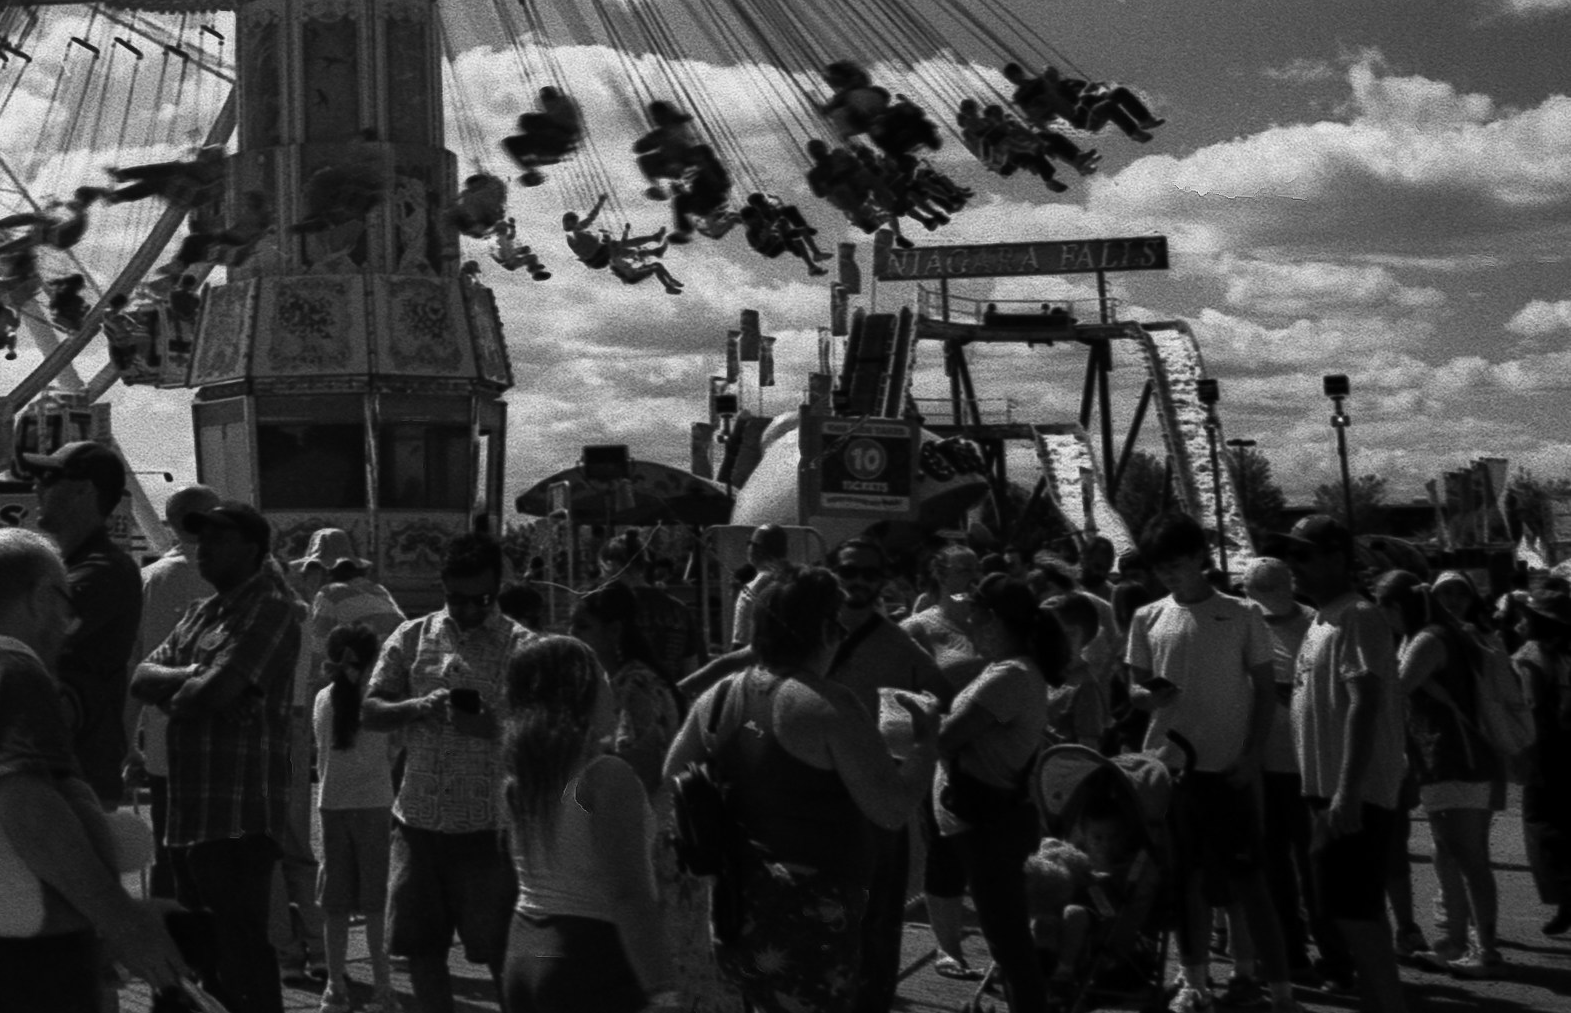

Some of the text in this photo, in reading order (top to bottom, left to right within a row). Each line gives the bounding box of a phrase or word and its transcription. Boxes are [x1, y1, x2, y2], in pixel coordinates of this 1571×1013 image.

[887, 239, 1160, 276] NIAGARA FALLS
[851, 448, 879, 471] 10
